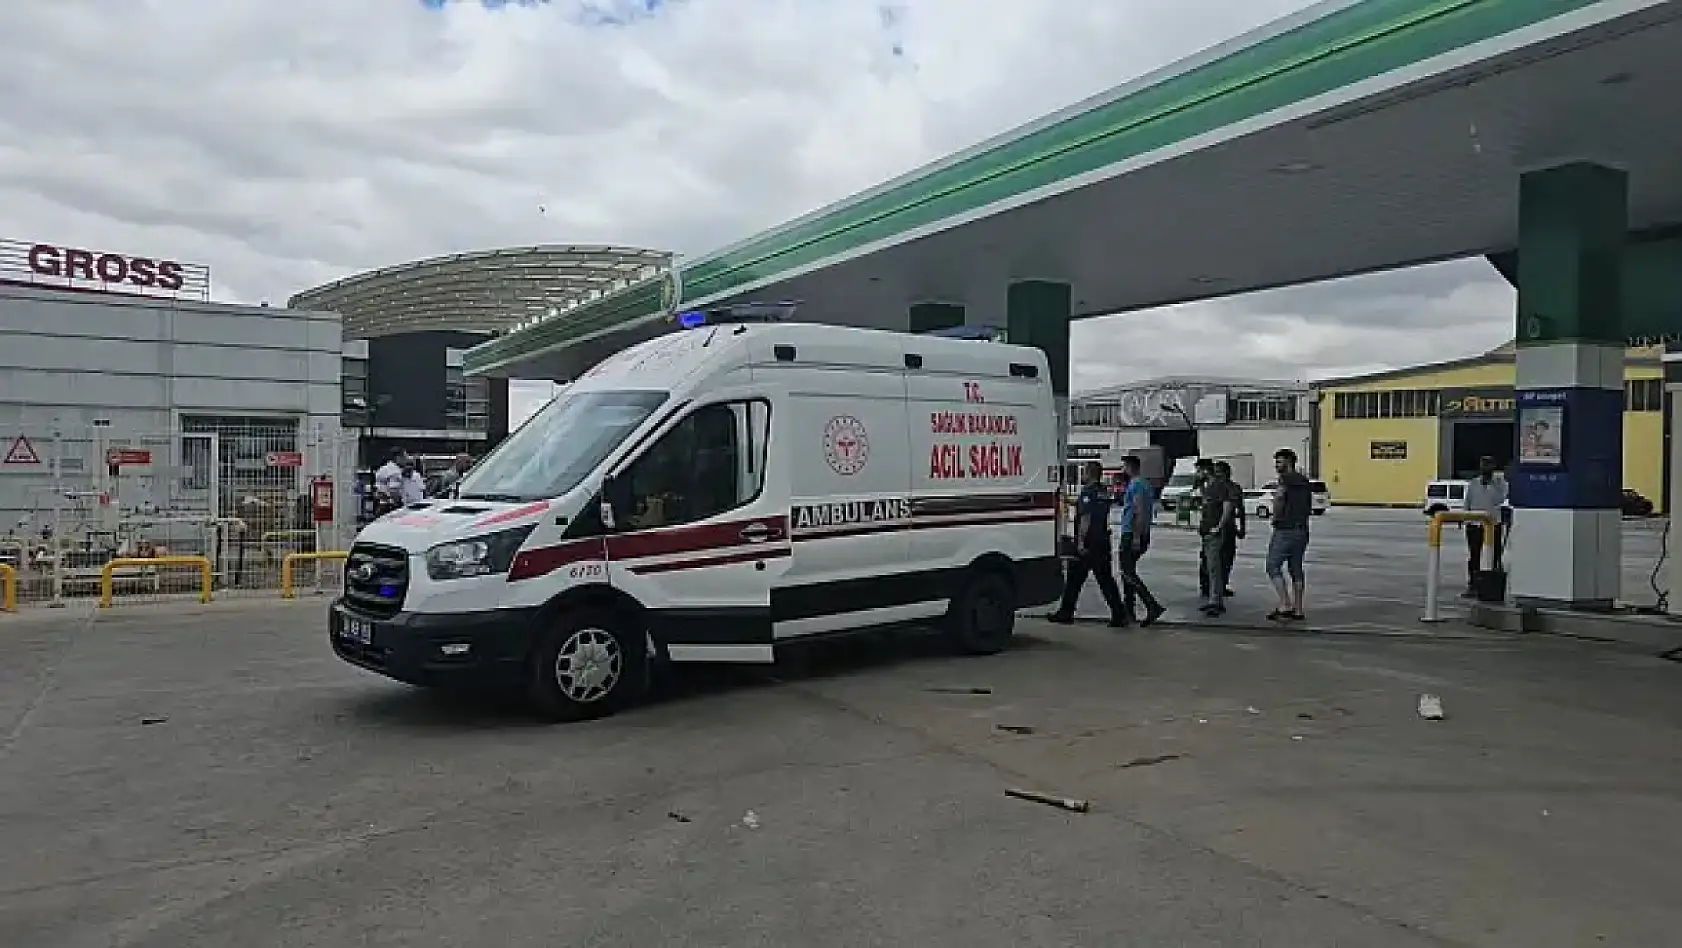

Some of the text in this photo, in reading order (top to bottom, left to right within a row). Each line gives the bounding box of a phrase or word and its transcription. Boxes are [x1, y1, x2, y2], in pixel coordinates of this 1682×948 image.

[28, 244, 184, 289] GROSS
[931, 410, 967, 433] SAĞLIK
[968, 441, 1023, 479] SAĞLIK
[798, 499, 911, 526] AMBULANS
